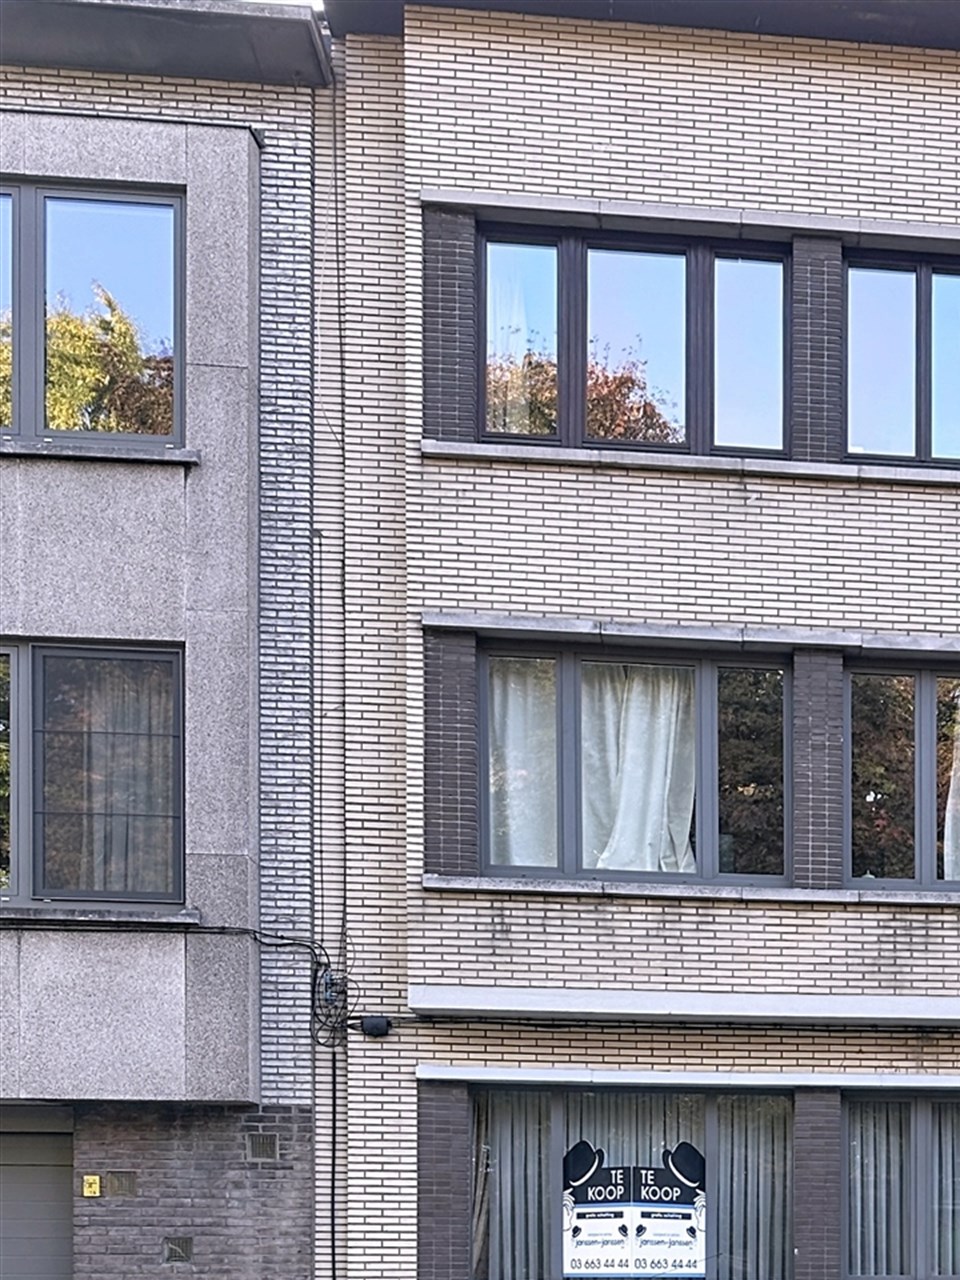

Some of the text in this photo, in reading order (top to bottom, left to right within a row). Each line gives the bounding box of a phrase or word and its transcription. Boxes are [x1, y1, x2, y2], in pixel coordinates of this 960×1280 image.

[610, 1170, 624, 1184] TE
[640, 1170, 655, 1185] TE
[587, 1186, 624, 1201] KOOP
[641, 1186, 681, 1201] KOOP
[570, 1258, 629, 1270] 03 663 44 44
[634, 1258, 698, 1270] 03 663 44 44
